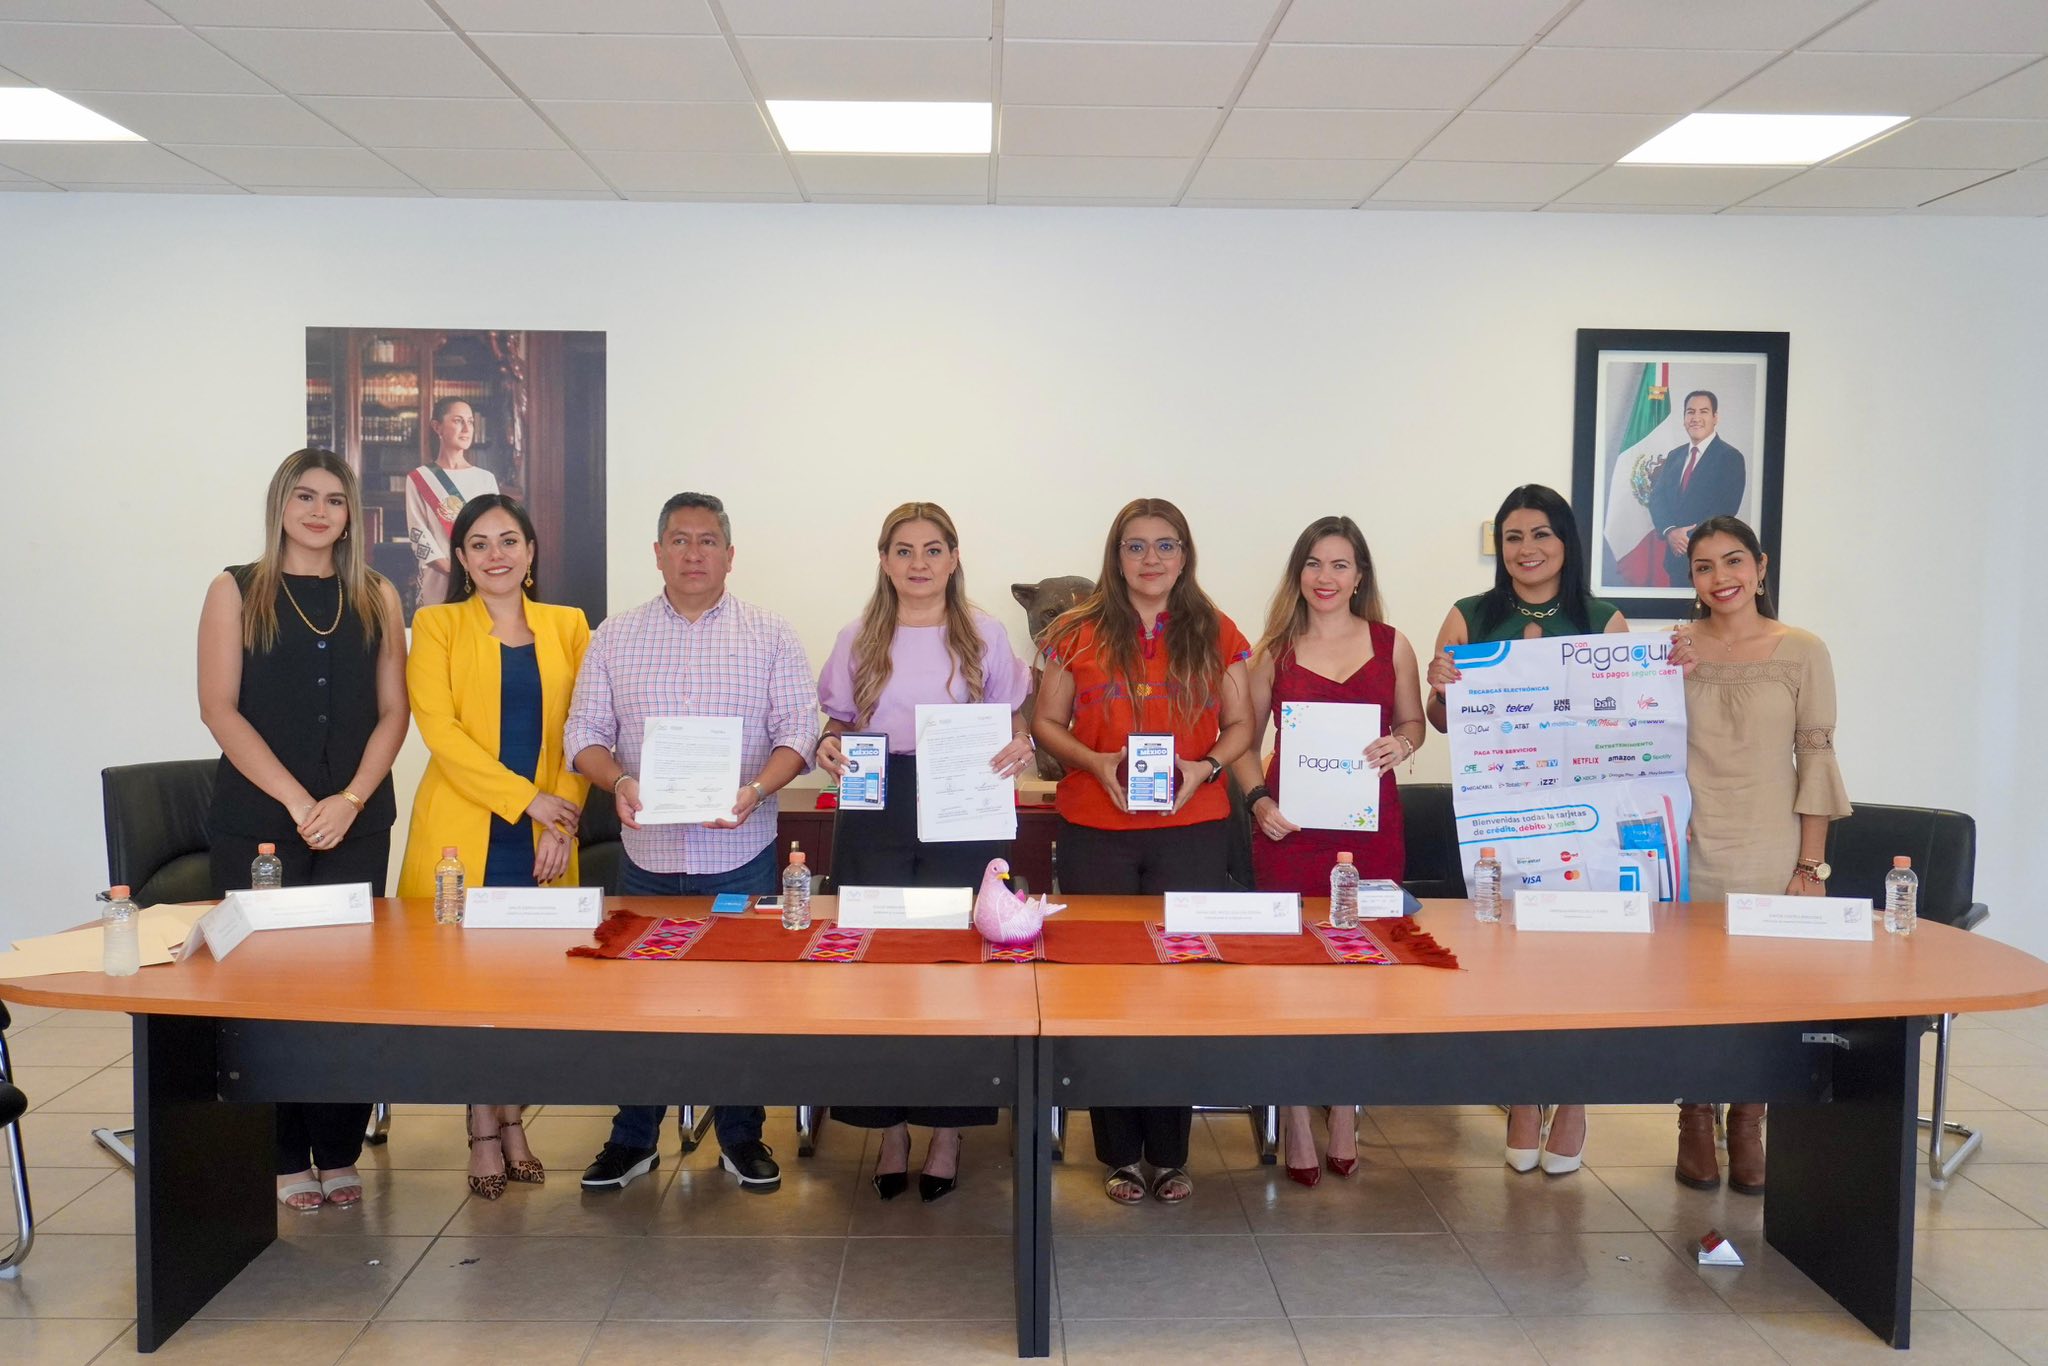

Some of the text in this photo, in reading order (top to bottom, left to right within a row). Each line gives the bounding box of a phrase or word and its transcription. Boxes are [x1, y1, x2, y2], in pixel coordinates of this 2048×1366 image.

[1606, 671, 1630, 679] pagos
[1632, 669, 1657, 678] seguro
[1505, 702, 1534, 713] telcel
[1594, 698, 1616, 708] bait
[1572, 757, 1599, 765] NETFLIX
[1472, 816, 1520, 826] Bienvenidas
[1522, 814, 1546, 822] todas
[1473, 828, 1484, 836] de
[1486, 824, 1518, 834] crédito,
[1518, 823, 1546, 832] débito
[1521, 875, 1541, 884] VISA
